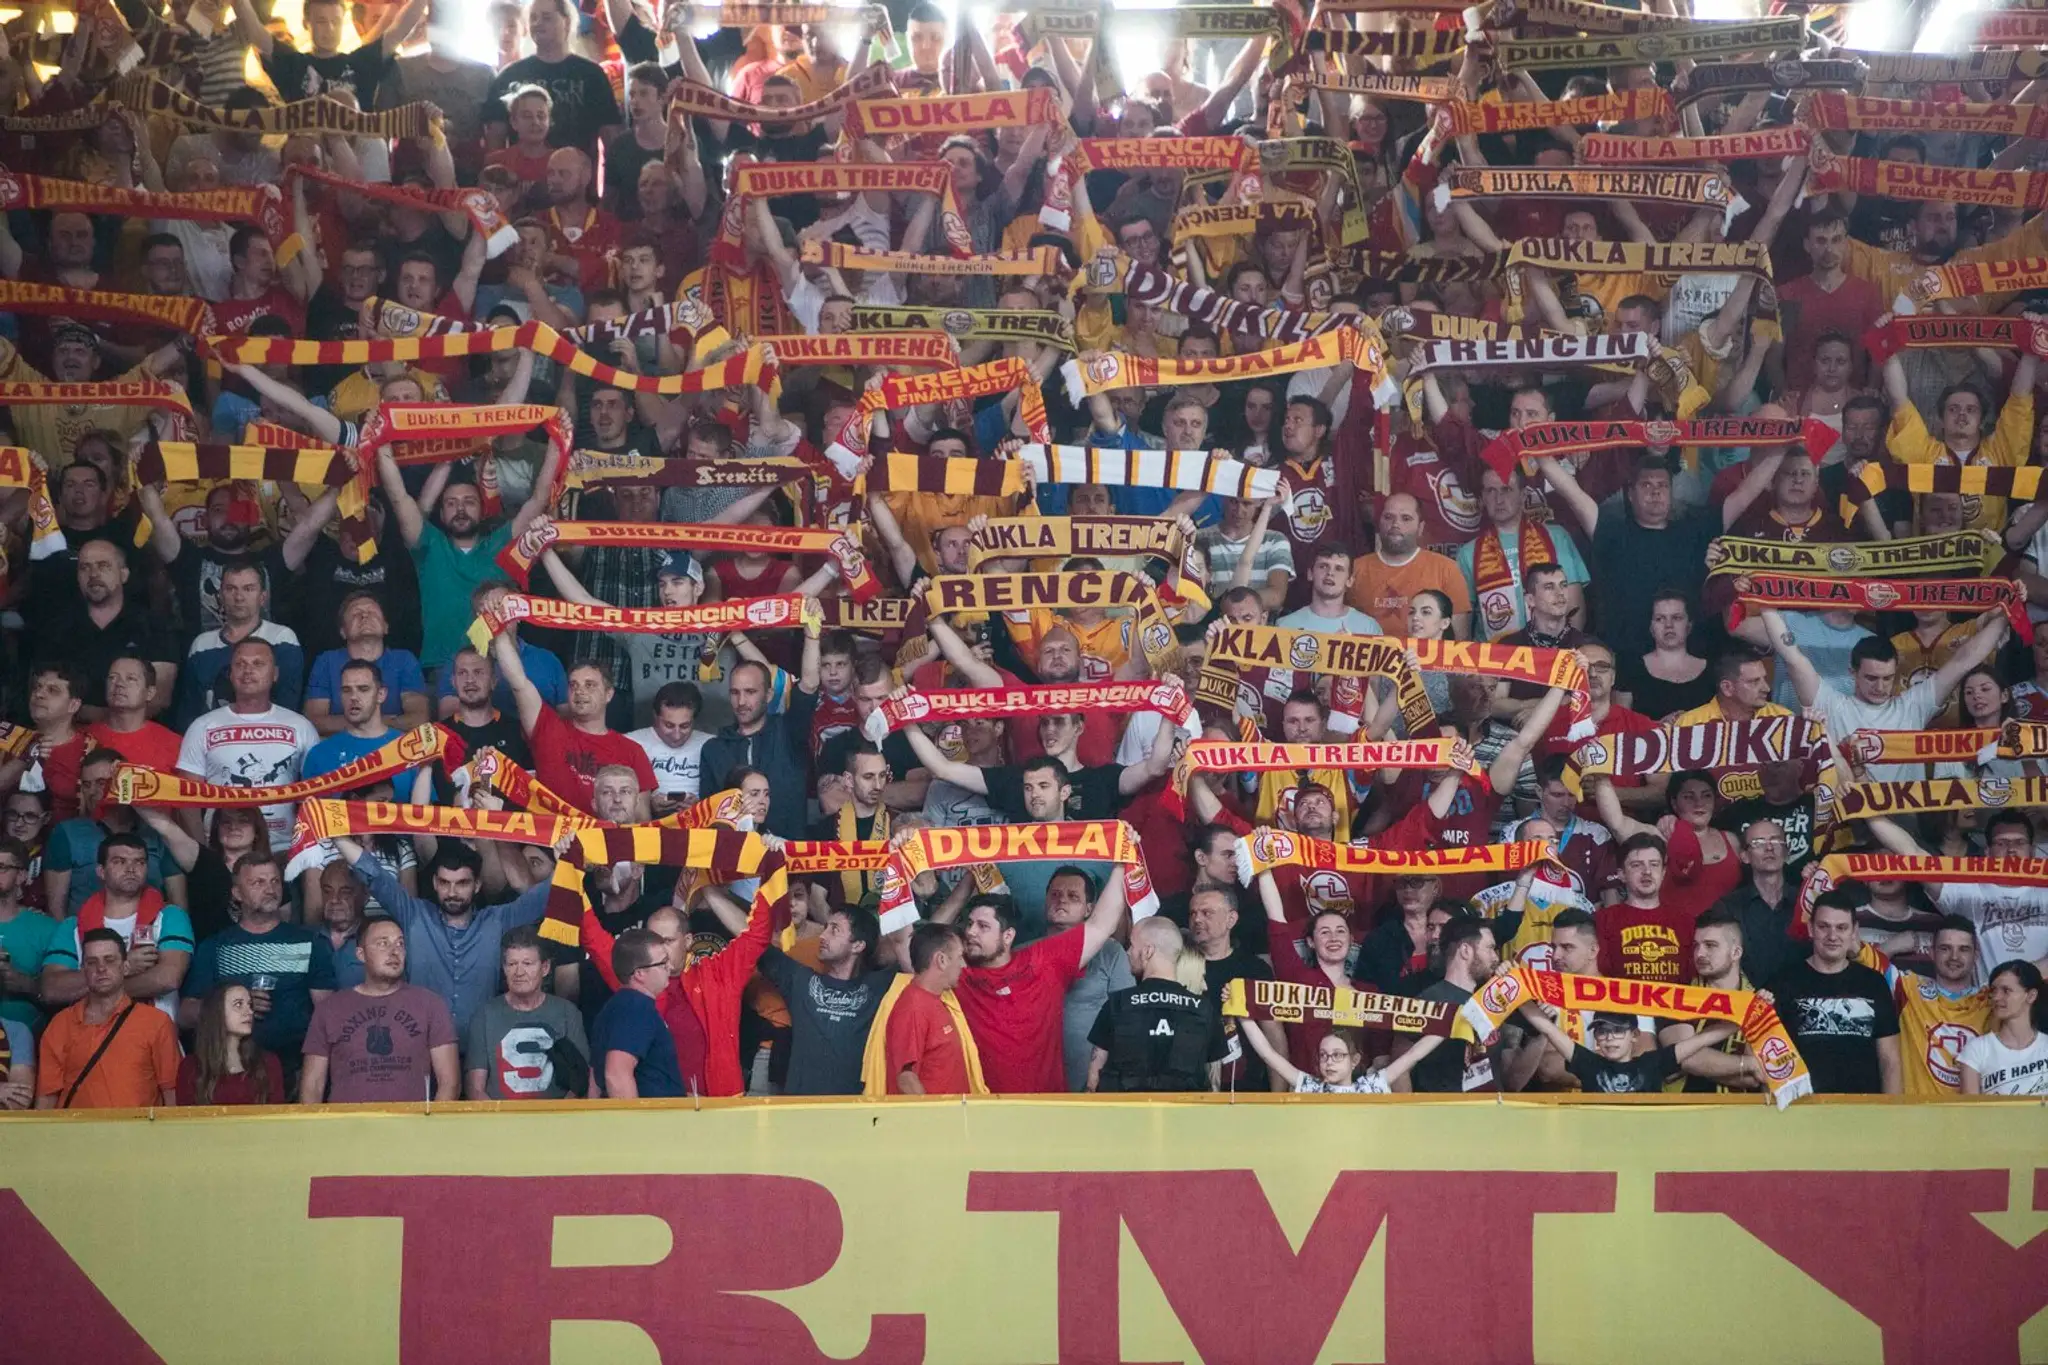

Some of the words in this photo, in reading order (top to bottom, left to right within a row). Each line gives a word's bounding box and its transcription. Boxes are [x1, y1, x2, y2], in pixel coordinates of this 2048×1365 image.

[1507, 41, 1620, 61] DUKLA
[869, 98, 1015, 128] DUKLA
[1497, 92, 1629, 119] TRENCIN
[1855, 99, 2015, 119] DUKLA
[1496, 113, 1556, 130] FINALE
[1861, 118, 1935, 130] FINALE
[1941, 119, 2013, 133] 2017/18
[1091, 140, 1239, 157] TRENCIN
[1585, 139, 1679, 158] DUKLA
[1102, 156, 1162, 168] FINALE
[1165, 156, 1231, 168] 2017/18
[749, 169, 837, 193] DUKLA
[1492, 173, 1573, 192] DUKLA
[1886, 164, 2015, 193] DUKLA
[1888, 186, 1948, 200] FINALE
[1952, 190, 2015, 205] 2017/18
[1522, 238, 1628, 264] DUKLA
[1908, 320, 2012, 341] DUKLA
[1177, 339, 1324, 375] DUKLA
[898, 383, 966, 405] FINALE
[407, 410, 460, 426] DUKLA
[1520, 422, 1628, 448] DUKLA
[589, 524, 672, 538] DUKLA
[530, 600, 620, 621] DUKLA
[653, 643, 701, 660] ESTA
[642, 664, 725, 684] BTCHS
[929, 693, 1026, 707] DUKLA
[211, 729, 236, 742] GET
[241, 728, 294, 742] MONEY
[1193, 746, 1284, 767] DUKLA
[368, 803, 536, 836] DUKLA
[929, 824, 1110, 860] DUKLA
[1347, 843, 1493, 867] DUKLA
[1849, 855, 1939, 873] DUKLA
[1621, 926, 1679, 946] DUKLA
[1131, 992, 1202, 1009] SECURITY
[1256, 981, 1332, 1005] DUKLA
[1574, 977, 1735, 1015] DUKLA
[1984, 1069, 2006, 1090] LIVE
